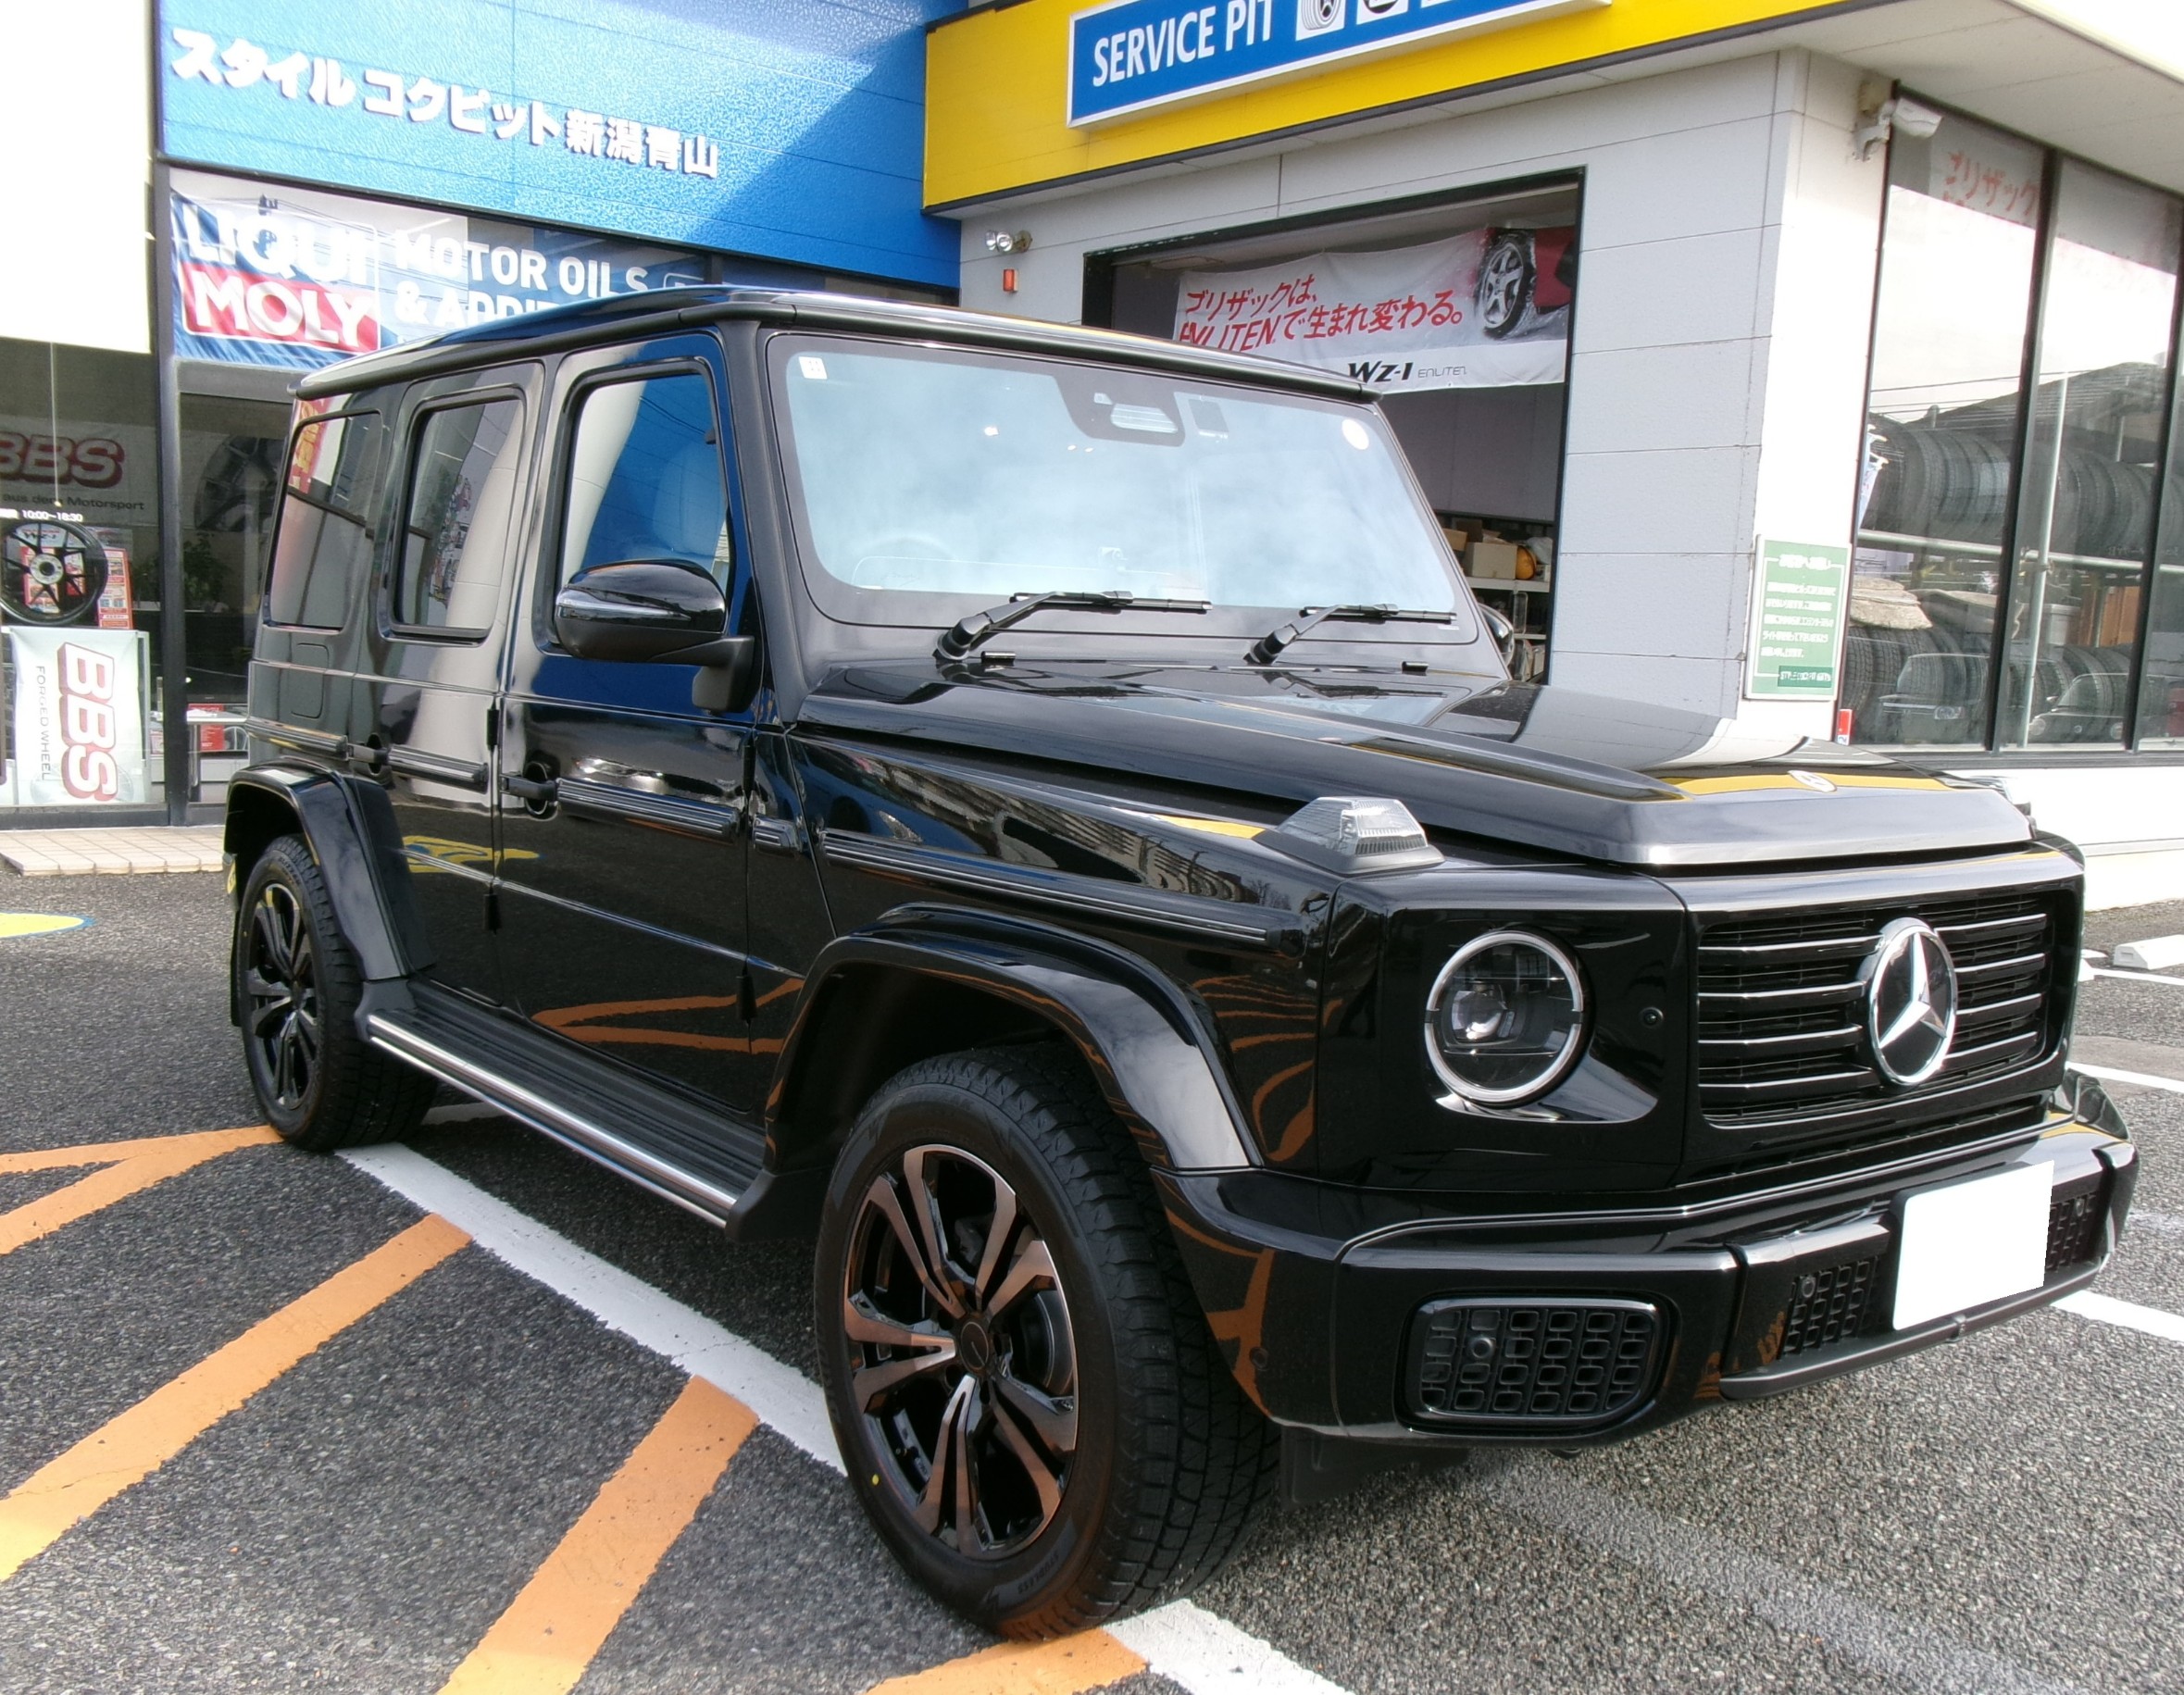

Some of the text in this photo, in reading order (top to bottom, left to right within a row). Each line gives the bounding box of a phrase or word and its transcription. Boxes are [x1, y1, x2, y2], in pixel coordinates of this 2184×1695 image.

[1092, 0, 1272, 87] SERVICE PIT
[170, 27, 718, 179] スタイルコクピット新潟青山
[182, 202, 368, 285] LIQUI
[395, 228, 648, 295] MOTOR OILS
[190, 270, 378, 348] MOLY
[395, 280, 430, 324] &
[1186, 274, 1317, 321] ゴリザックは、
[1417, 366, 1467, 379] ENLITEN
[67, 496, 145, 510] Motorsport
[36, 665, 52, 781] FORGED WHEEL
[57, 642, 119, 802] BBS
